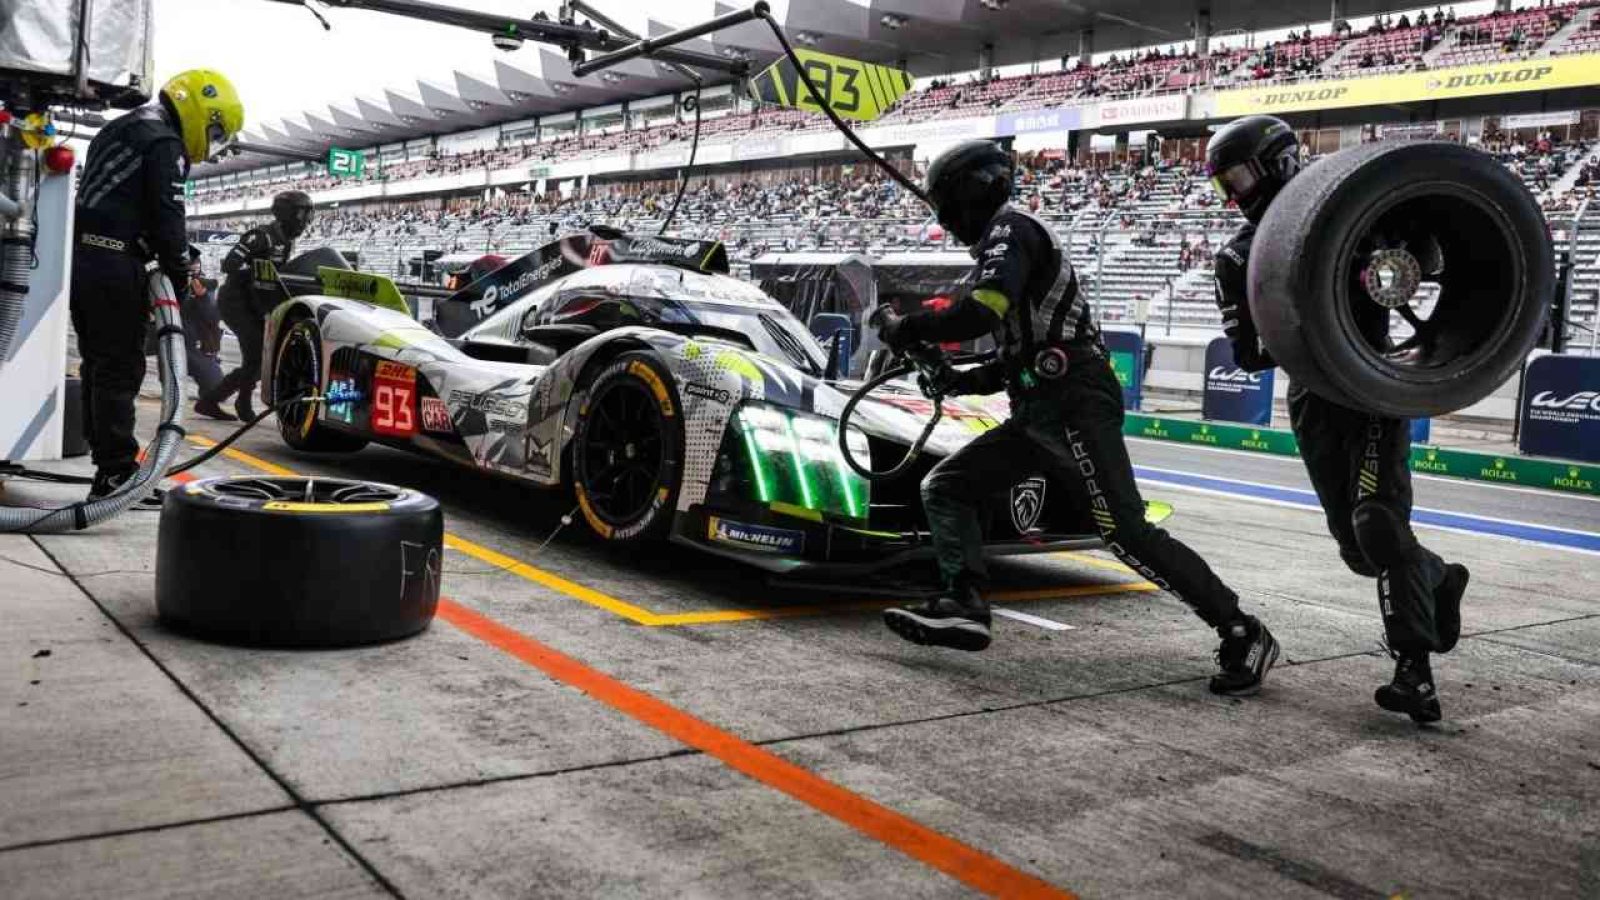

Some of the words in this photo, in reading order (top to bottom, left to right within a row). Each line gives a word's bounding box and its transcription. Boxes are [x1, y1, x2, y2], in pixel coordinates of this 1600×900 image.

[803, 59, 860, 112] 93
[1445, 66, 1553, 88] DUNLOP
[1264, 86, 1348, 106] DUNLOP
[333, 152, 357, 172] 21
[375, 385, 414, 431] 93
[1064, 426, 1109, 510] SPORT
[1414, 460, 1448, 472] ROLEX
[1481, 468, 1517, 480] ROLEX
[1554, 477, 1592, 489] ROLEX
[729, 529, 794, 546] MICHELIN
